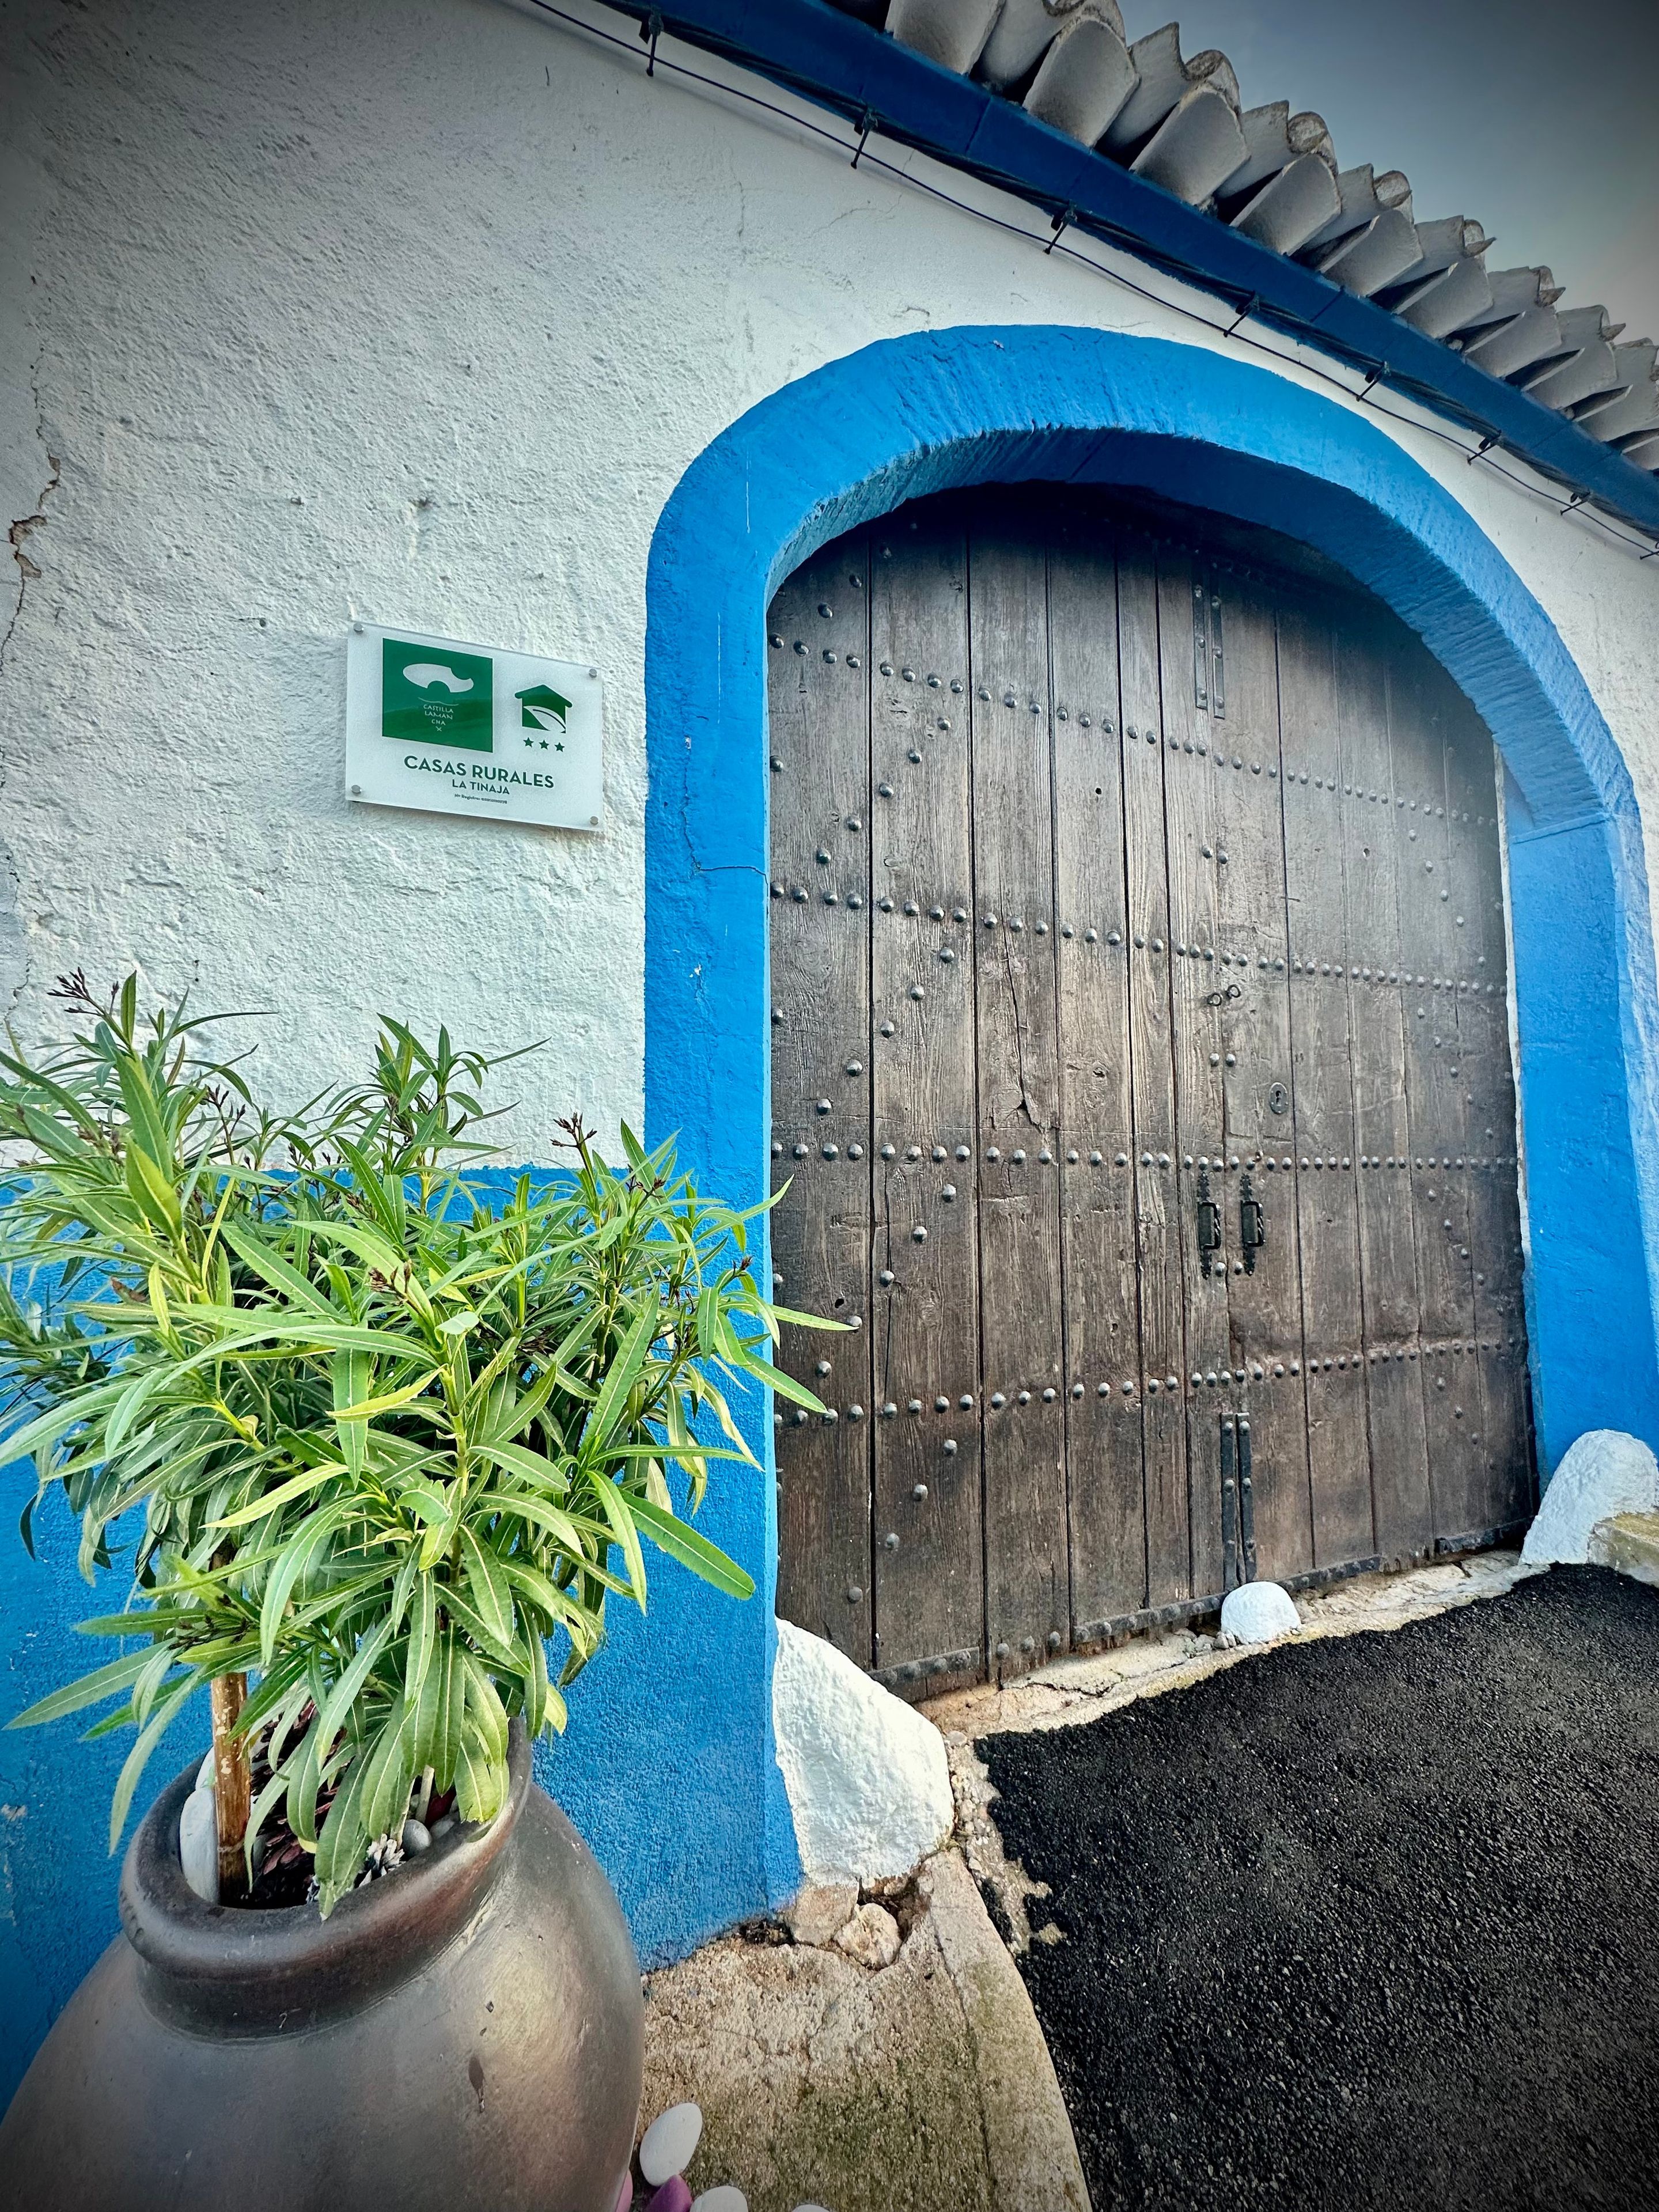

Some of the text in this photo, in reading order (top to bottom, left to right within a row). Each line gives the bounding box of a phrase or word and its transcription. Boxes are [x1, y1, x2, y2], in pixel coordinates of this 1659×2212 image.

[423, 704, 454, 714] CASTILLA
[404, 755, 554, 789] CASAS RURALES
[452, 779, 510, 795] LA TINAJA
